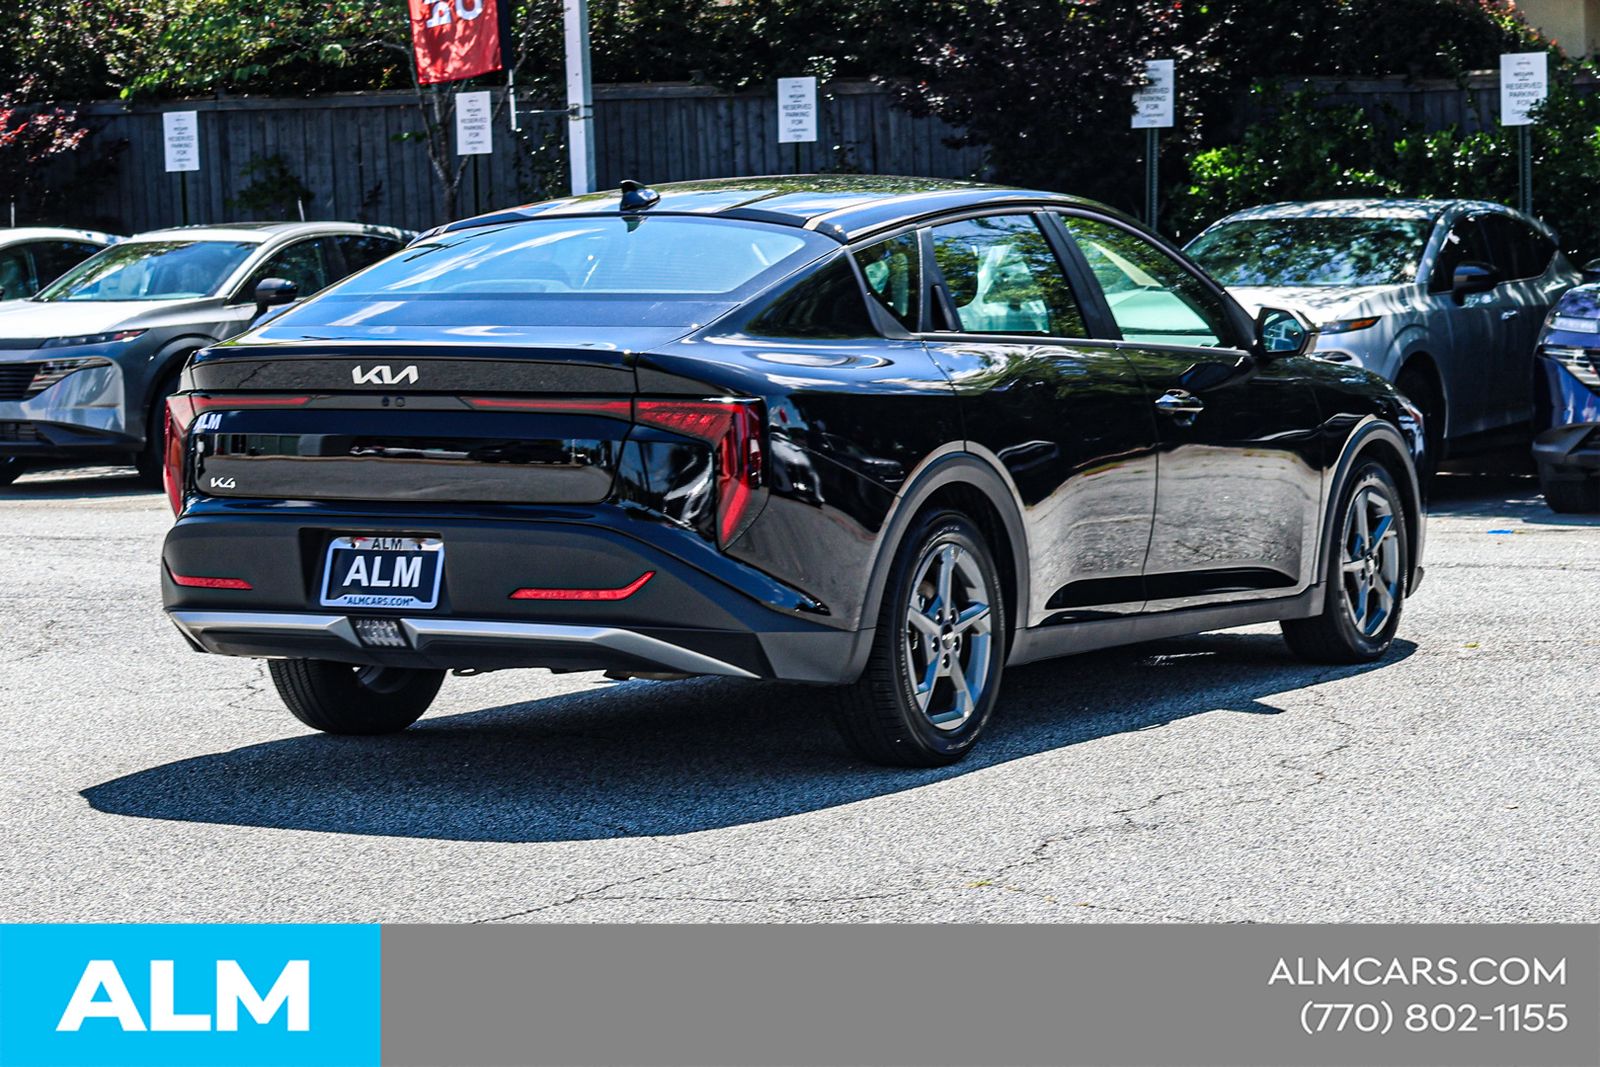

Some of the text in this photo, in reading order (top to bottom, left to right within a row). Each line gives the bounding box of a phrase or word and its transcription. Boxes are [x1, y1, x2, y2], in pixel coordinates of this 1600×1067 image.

[1139, 87, 1169, 95] ESERVED
[1505, 82, 1543, 90] RESERVED
[782, 103, 813, 111] RESERVED
[352, 365, 419, 384] KIA
[210, 477, 236, 489] K4
[372, 538, 403, 550] ALM
[342, 555, 422, 588] ALM
